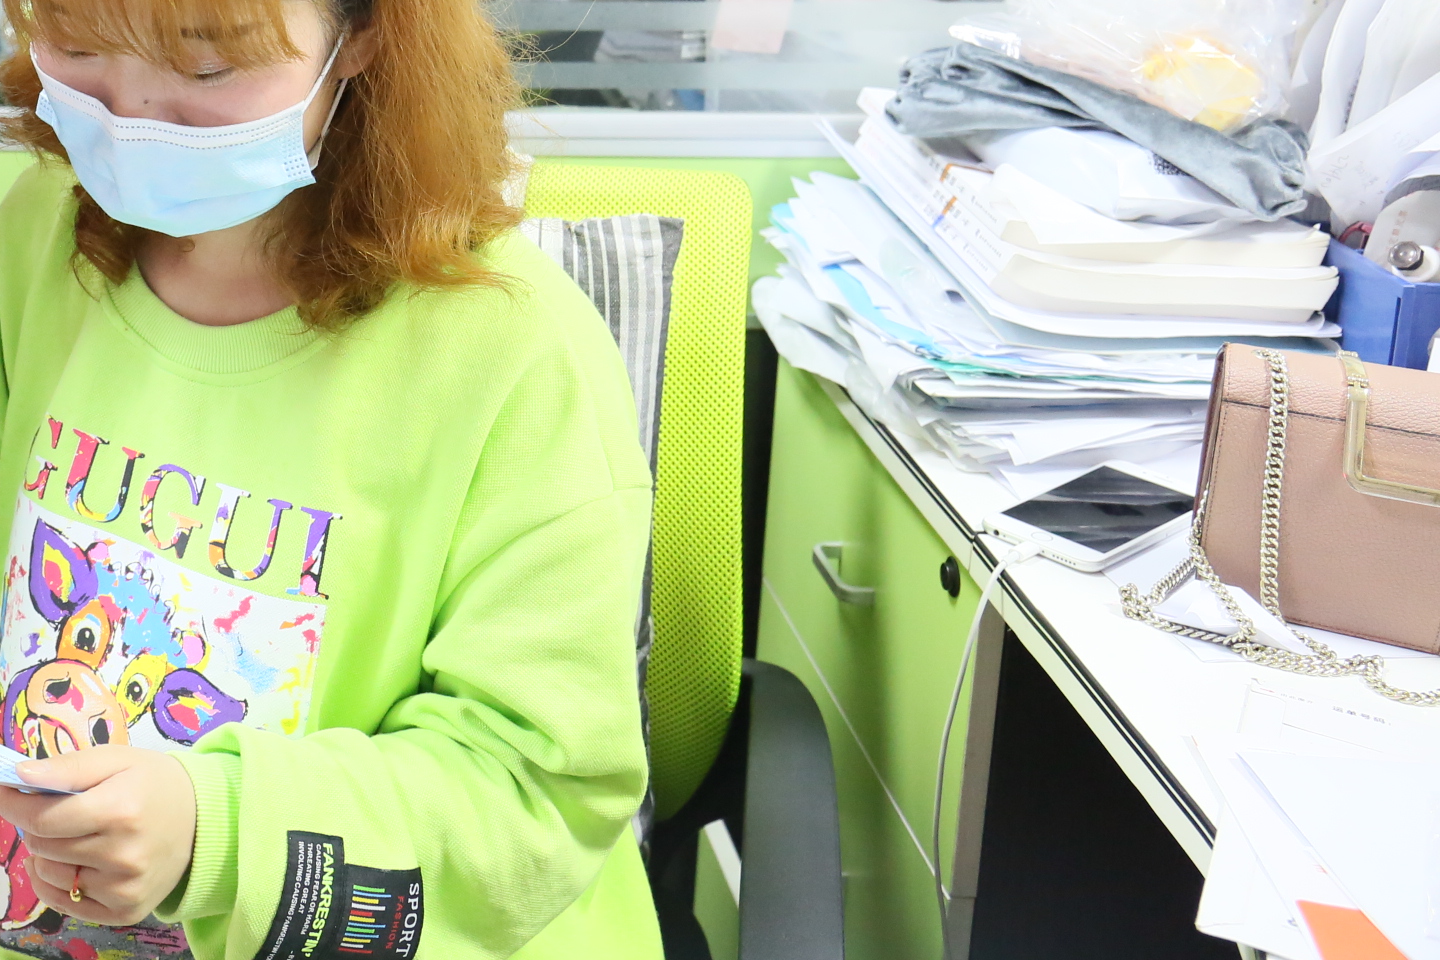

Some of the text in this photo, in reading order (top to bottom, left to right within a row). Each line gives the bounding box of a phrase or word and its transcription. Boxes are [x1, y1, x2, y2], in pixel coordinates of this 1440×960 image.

[23, 411, 344, 601] GUGUI
[295, 841, 305, 882] INVOLVING
[314, 843, 322, 880] CAUSING
[287, 882, 301, 916] CAUSING
[310, 880, 320, 902] FEAR
[300, 914, 313, 935] HARM
[385, 895, 405, 950] FASHION
[395, 882, 420, 959] SPORT
